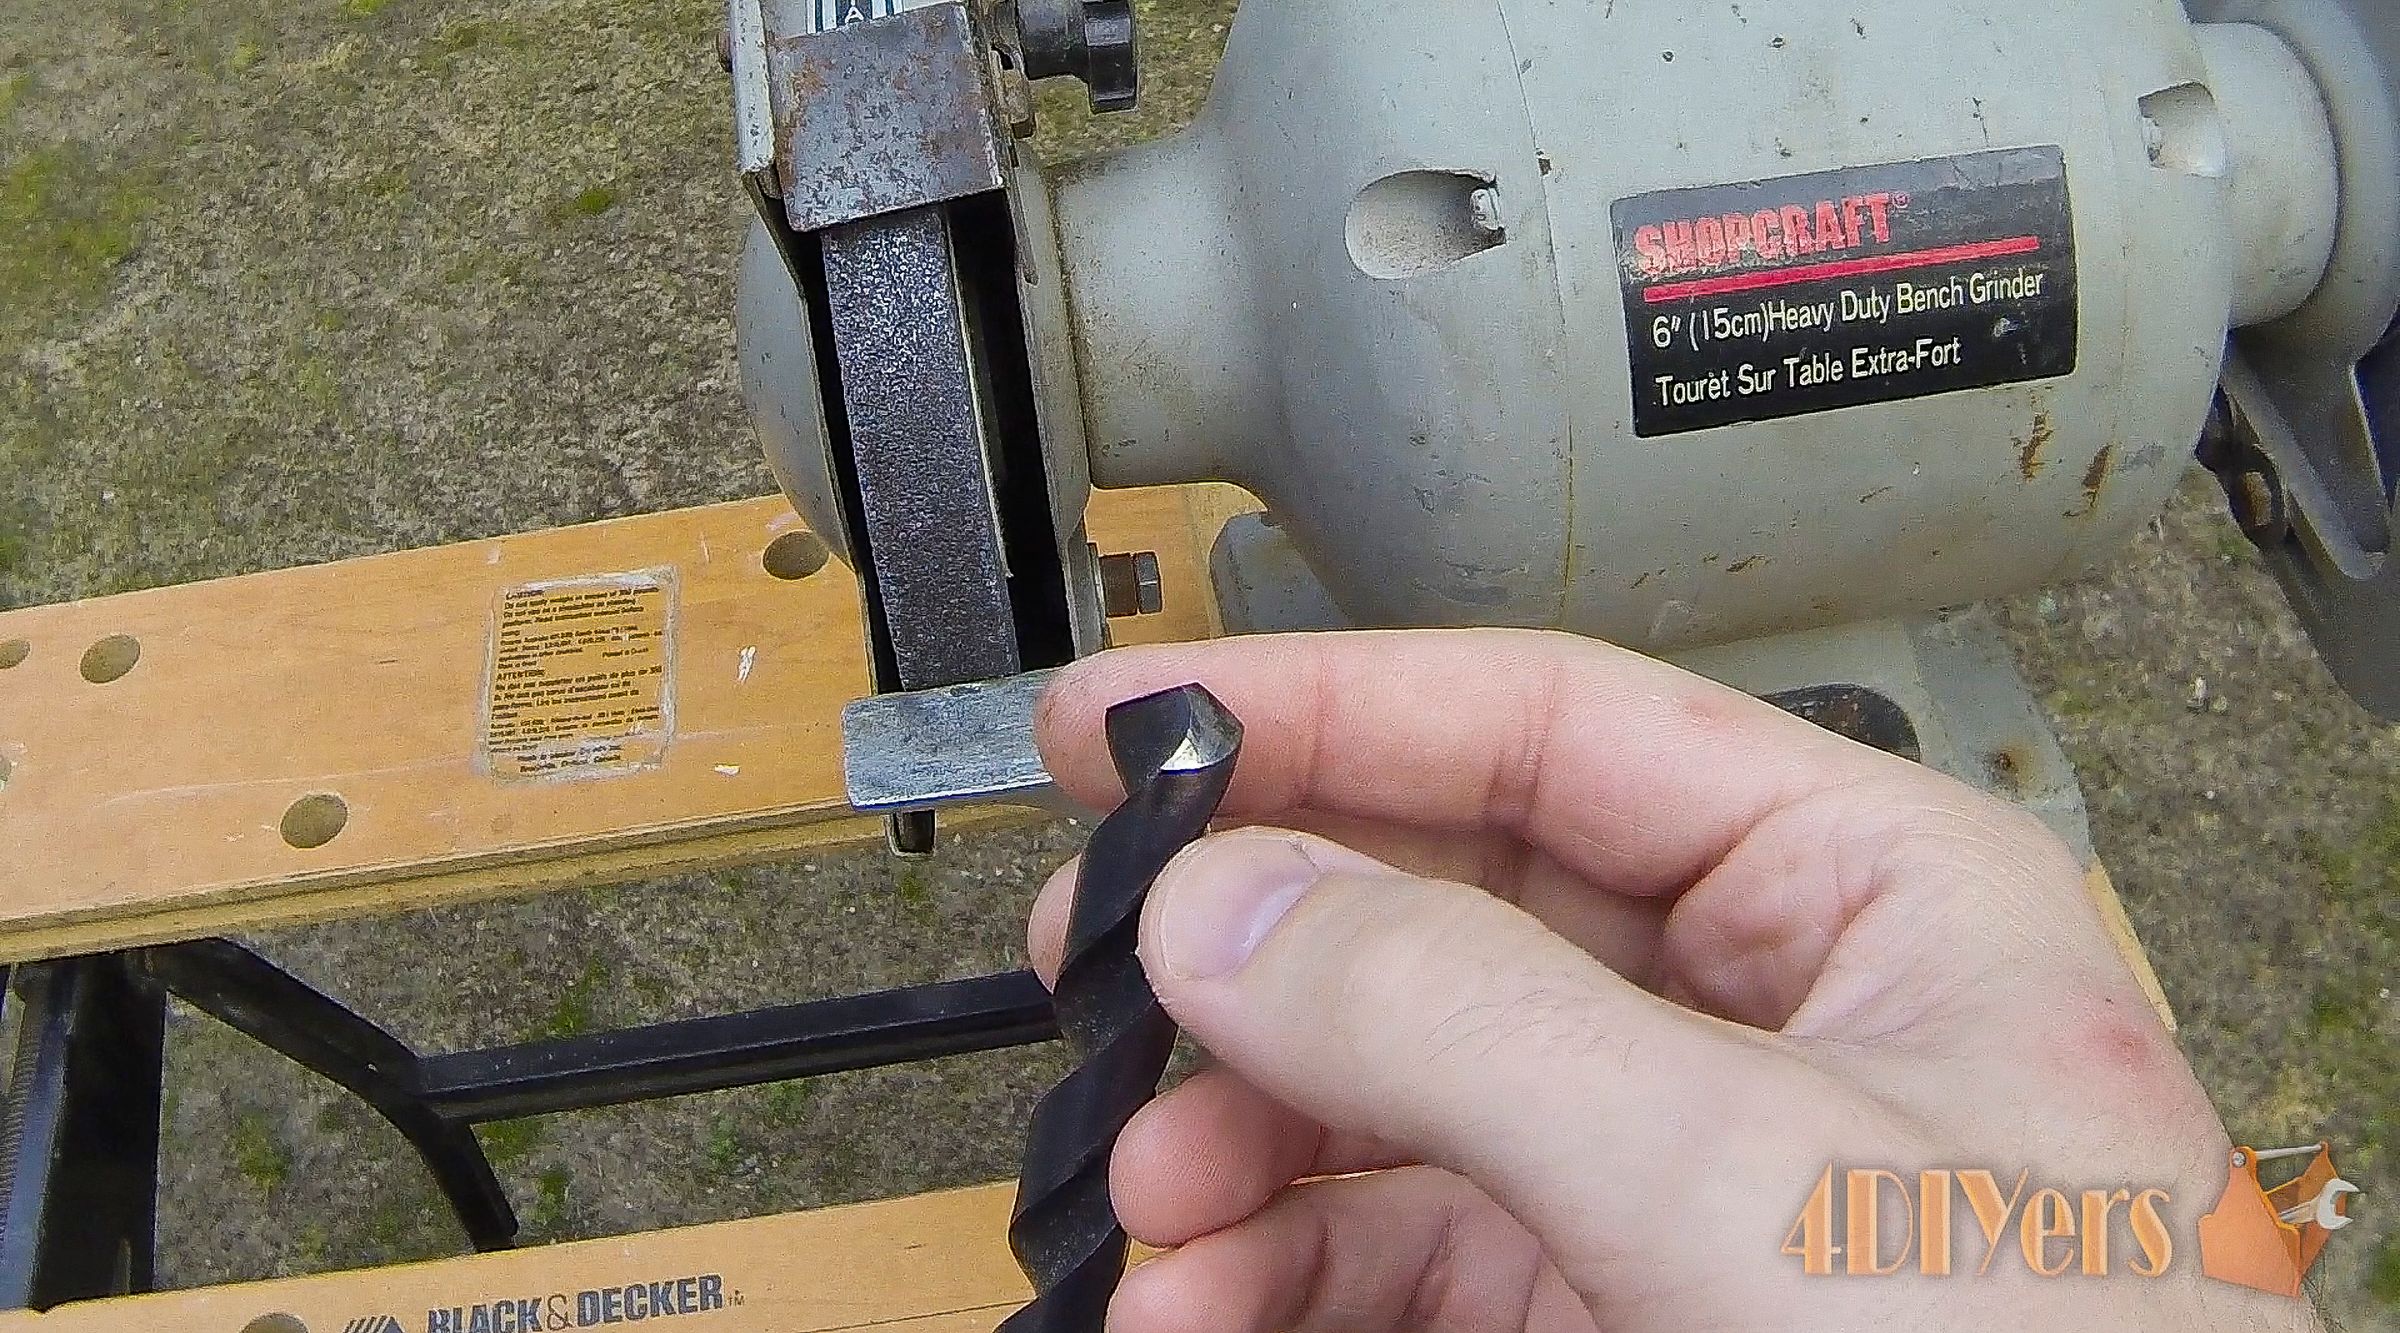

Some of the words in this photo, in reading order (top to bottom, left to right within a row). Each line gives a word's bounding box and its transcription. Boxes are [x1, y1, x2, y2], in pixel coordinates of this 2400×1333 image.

[1840, 289, 1890, 325] Duty
[1896, 275, 1964, 312] Bench
[1969, 271, 2043, 306] Grinder
[1737, 364, 1777, 396] Sur
[1783, 351, 1844, 389] Table
[1851, 335, 1962, 377] Extra-Fort
